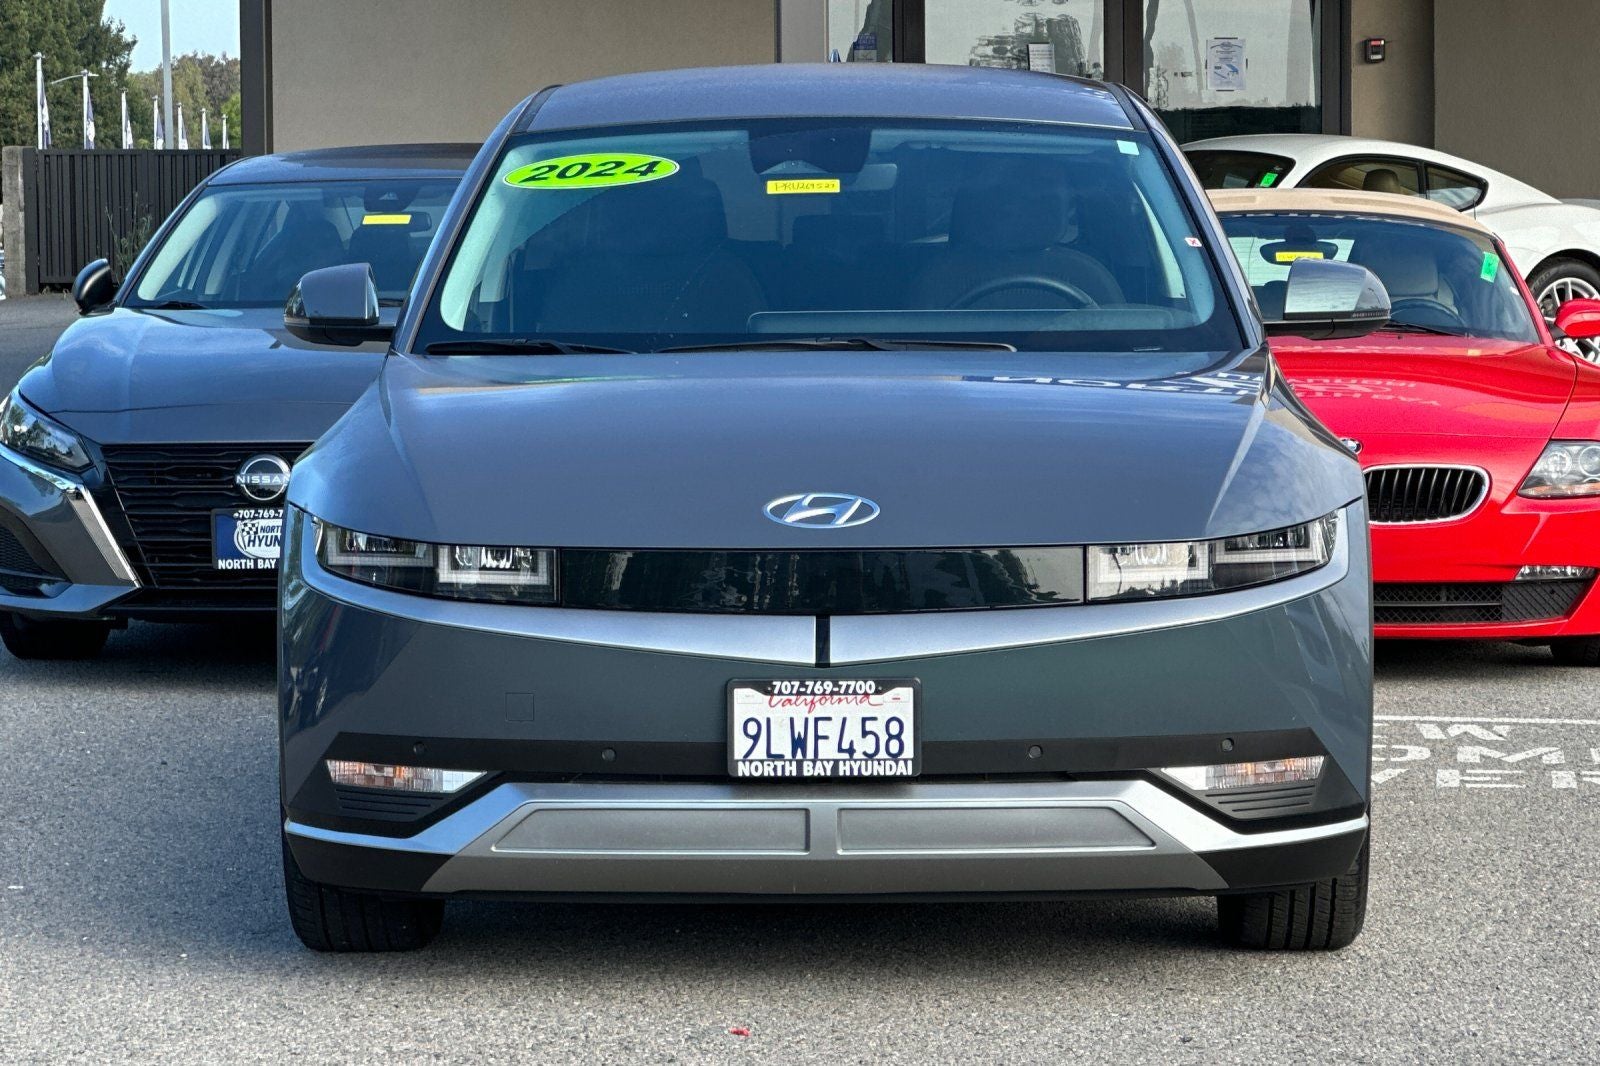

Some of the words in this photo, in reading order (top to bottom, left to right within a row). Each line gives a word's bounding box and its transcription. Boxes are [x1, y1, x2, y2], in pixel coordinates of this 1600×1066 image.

[519, 160, 662, 183] 2024
[236, 475, 290, 484] NISSAN
[217, 559, 255, 570] NORTH
[257, 559, 277, 570] BAY
[771, 680, 876, 695] 707-769-7700
[768, 692, 884, 715] California
[742, 716, 905, 759] 9LWF458
[737, 760, 797, 777] NORTH
[803, 760, 835, 777] BAY
[838, 760, 913, 777] HYUNDAI
